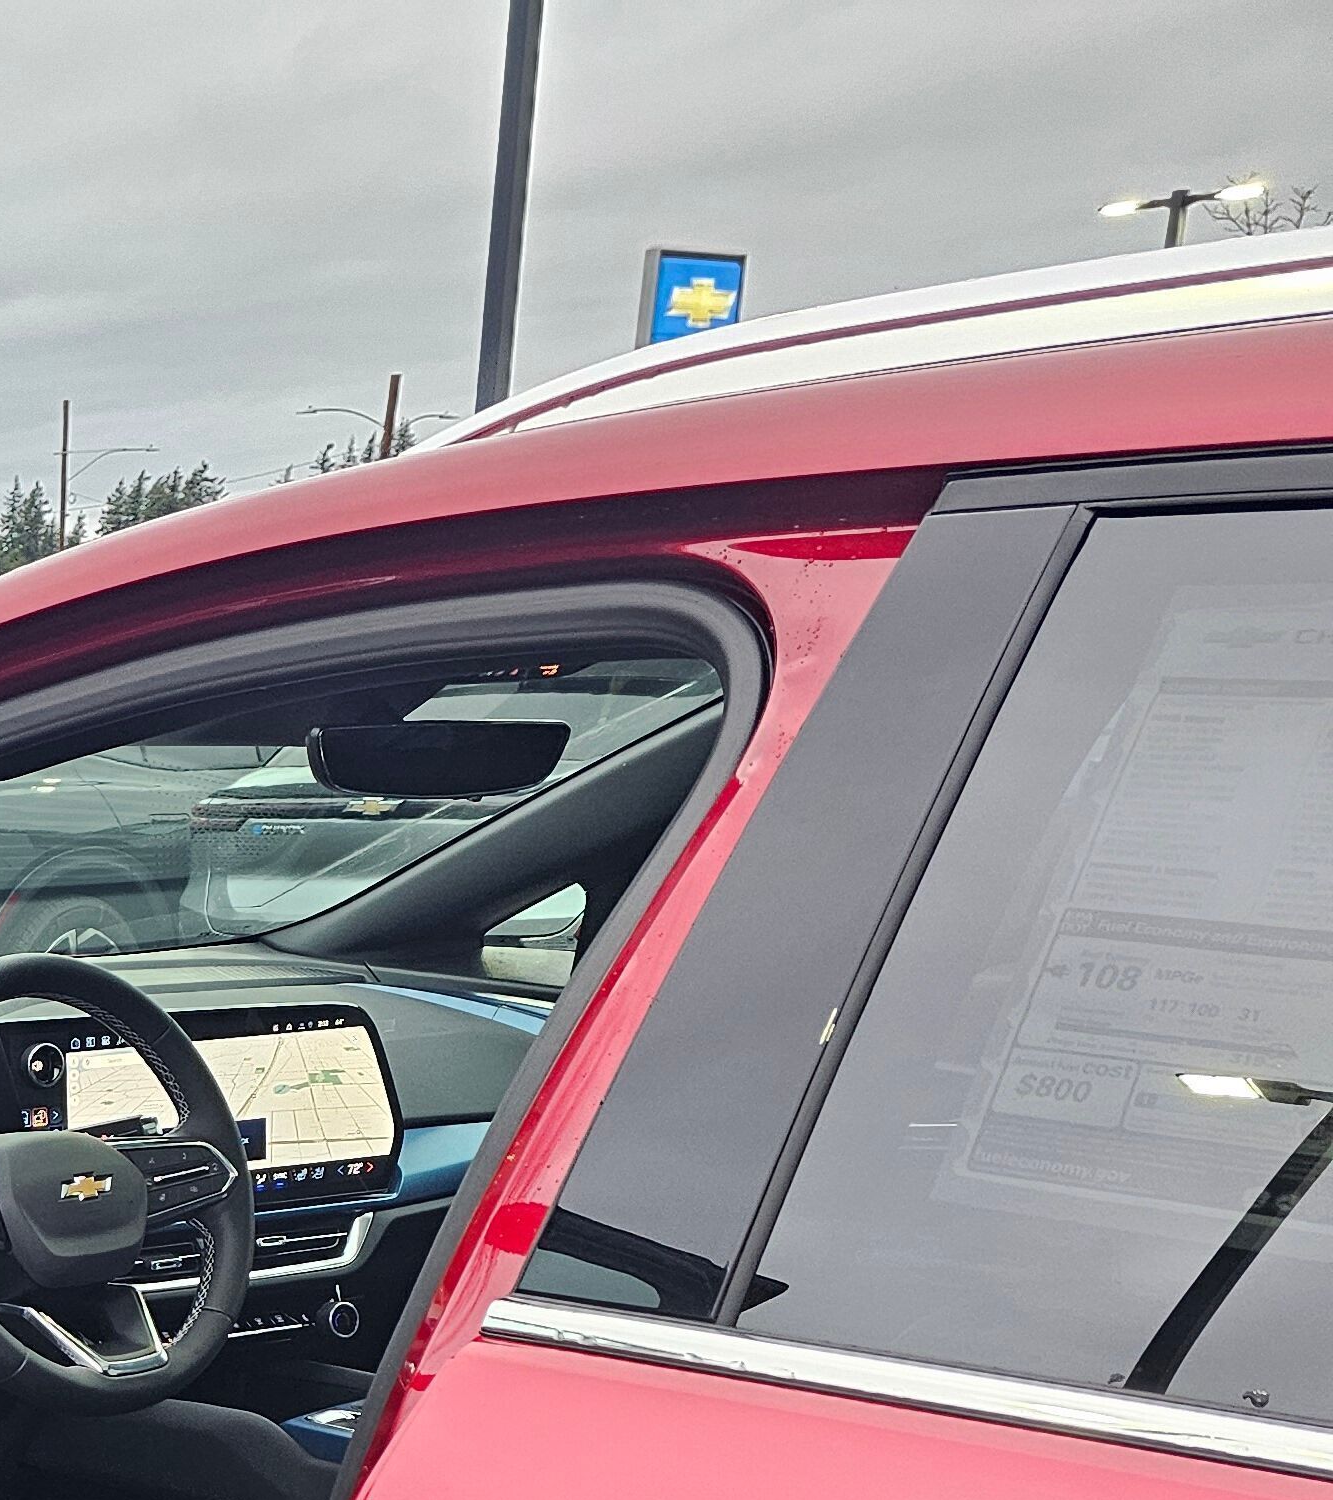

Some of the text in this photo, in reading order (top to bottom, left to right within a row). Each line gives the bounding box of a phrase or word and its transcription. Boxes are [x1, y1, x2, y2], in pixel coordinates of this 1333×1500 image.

[1098, 919, 1131, 933] Fuel
[1134, 921, 1210, 943] Economy
[1078, 961, 1143, 991] 108
[1153, 967, 1205, 984] MPGe
[1082, 1061, 1136, 1080] cost
[1014, 1071, 1093, 1103] $800
[974, 1146, 1132, 1183] fueleconomy.gov
